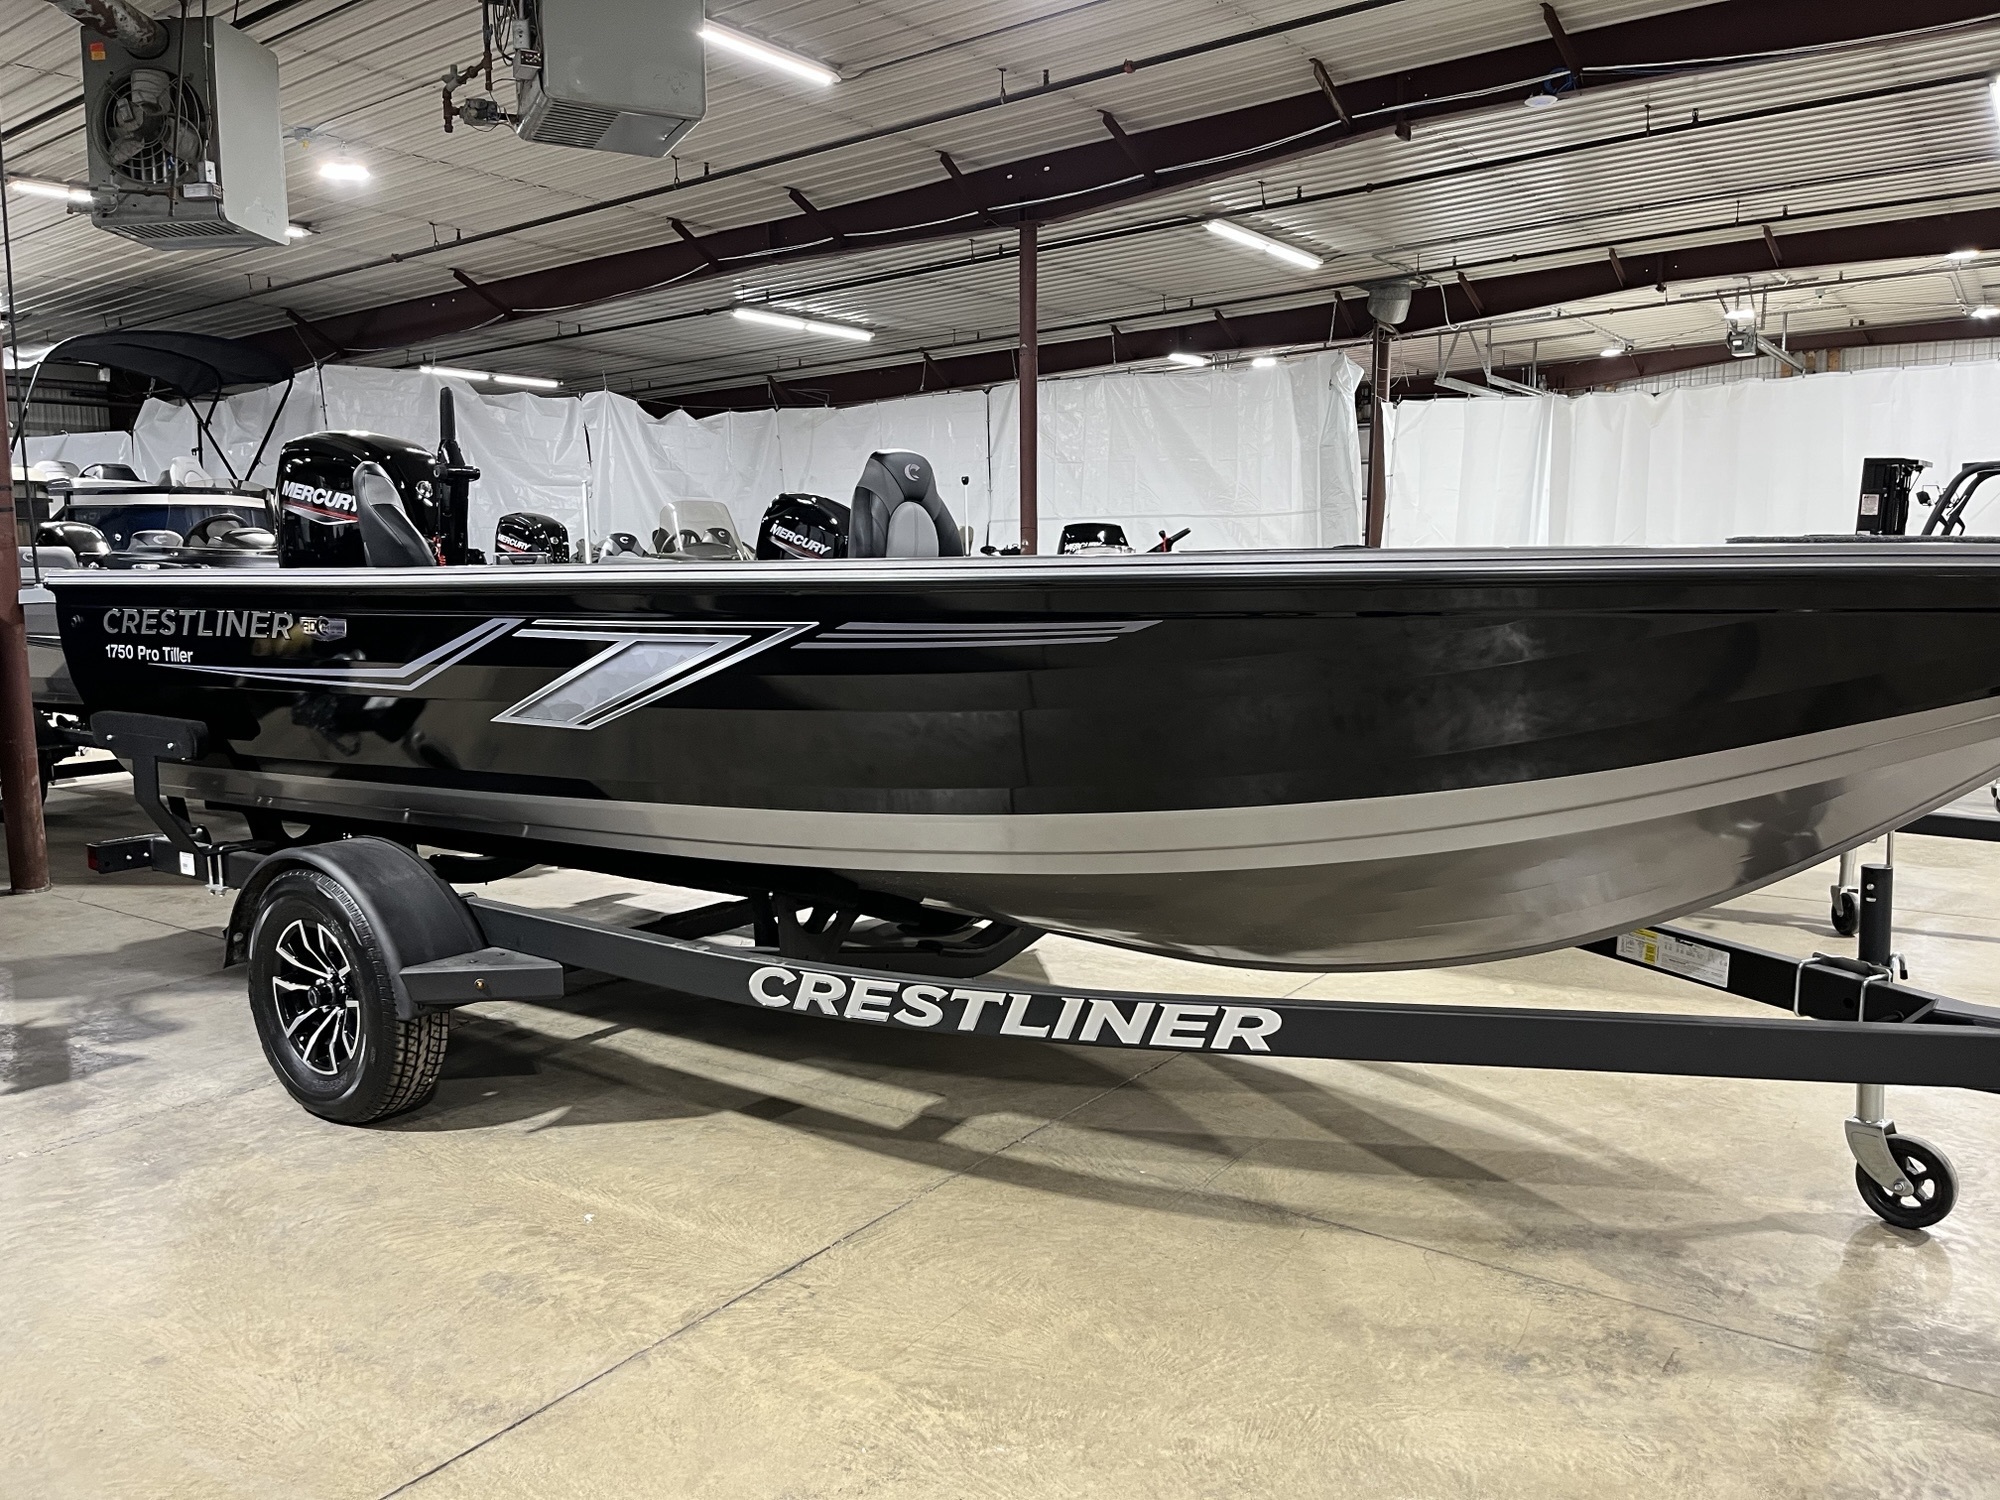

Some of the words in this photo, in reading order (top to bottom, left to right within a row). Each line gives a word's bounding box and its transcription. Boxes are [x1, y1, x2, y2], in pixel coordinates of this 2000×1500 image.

[497, 533, 532, 551] MERCURY
[769, 523, 832, 555] MERCURY
[103, 607, 294, 640] CRESTLINER
[105, 644, 134, 660] 1750
[137, 645, 160, 661] Pro
[162, 646, 194, 663] Tiller
[748, 966, 1283, 1052] CRESTLINER
